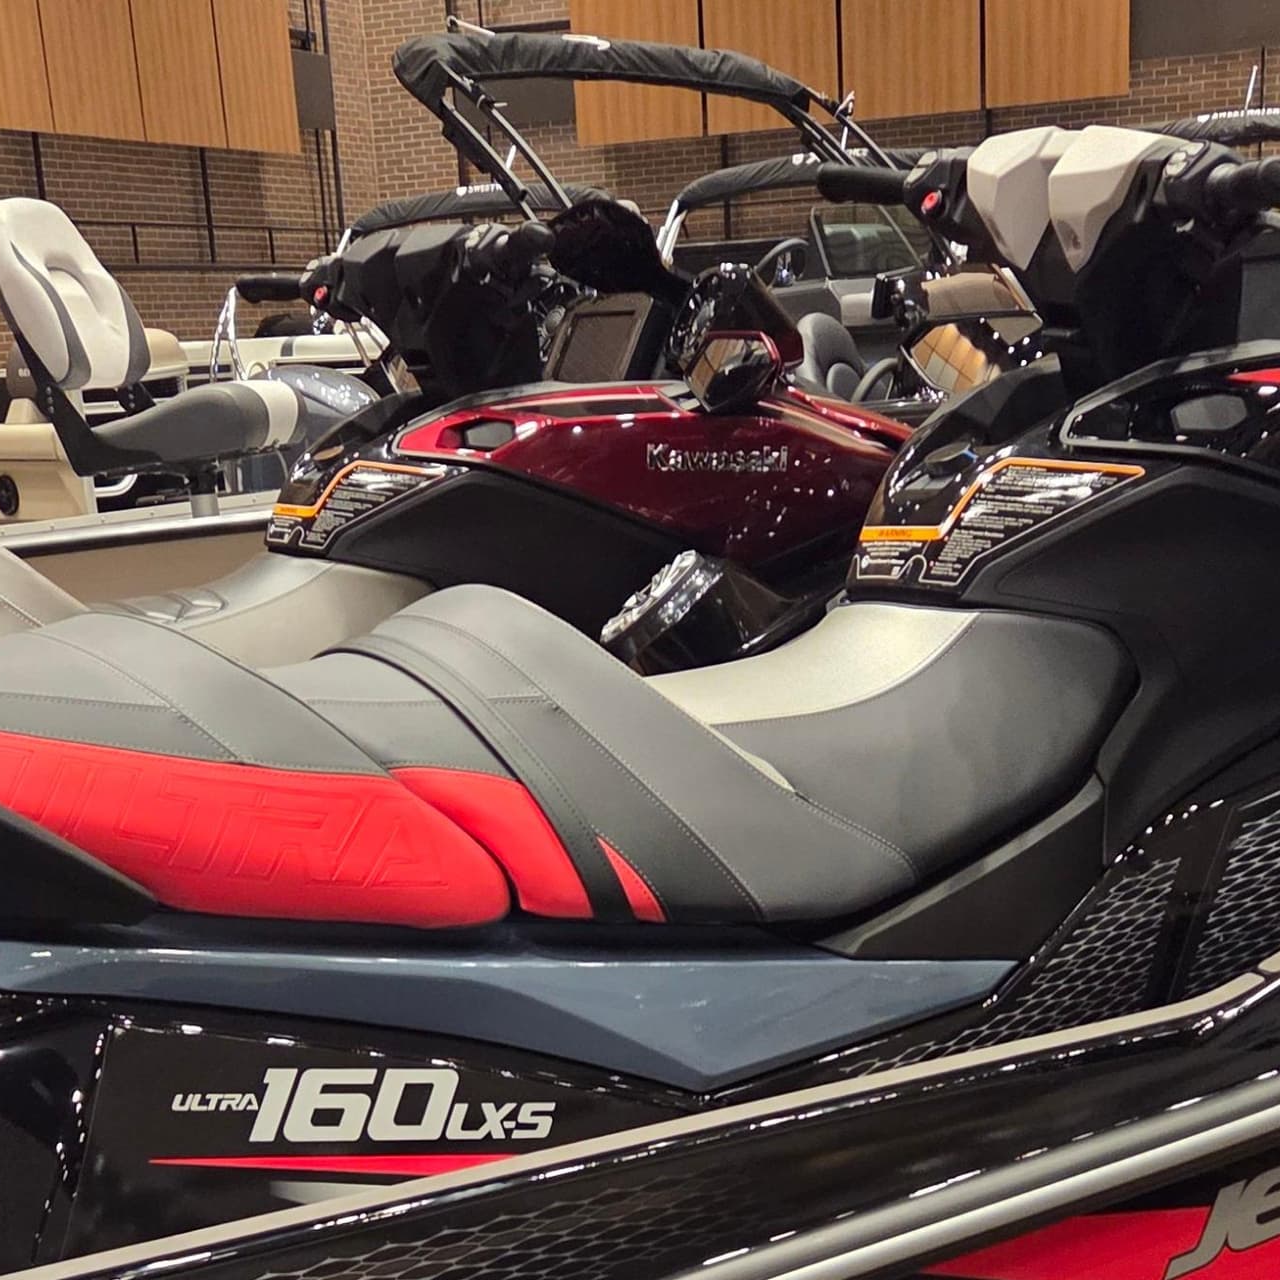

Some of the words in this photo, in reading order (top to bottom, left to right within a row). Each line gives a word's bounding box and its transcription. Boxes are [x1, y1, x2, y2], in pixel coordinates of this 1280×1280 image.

[645, 443, 788, 472] Kawasaki
[172, 1092, 259, 1112] ULTRA
[249, 1067, 460, 1143] 160
[445, 1101, 557, 1140] LX-S
